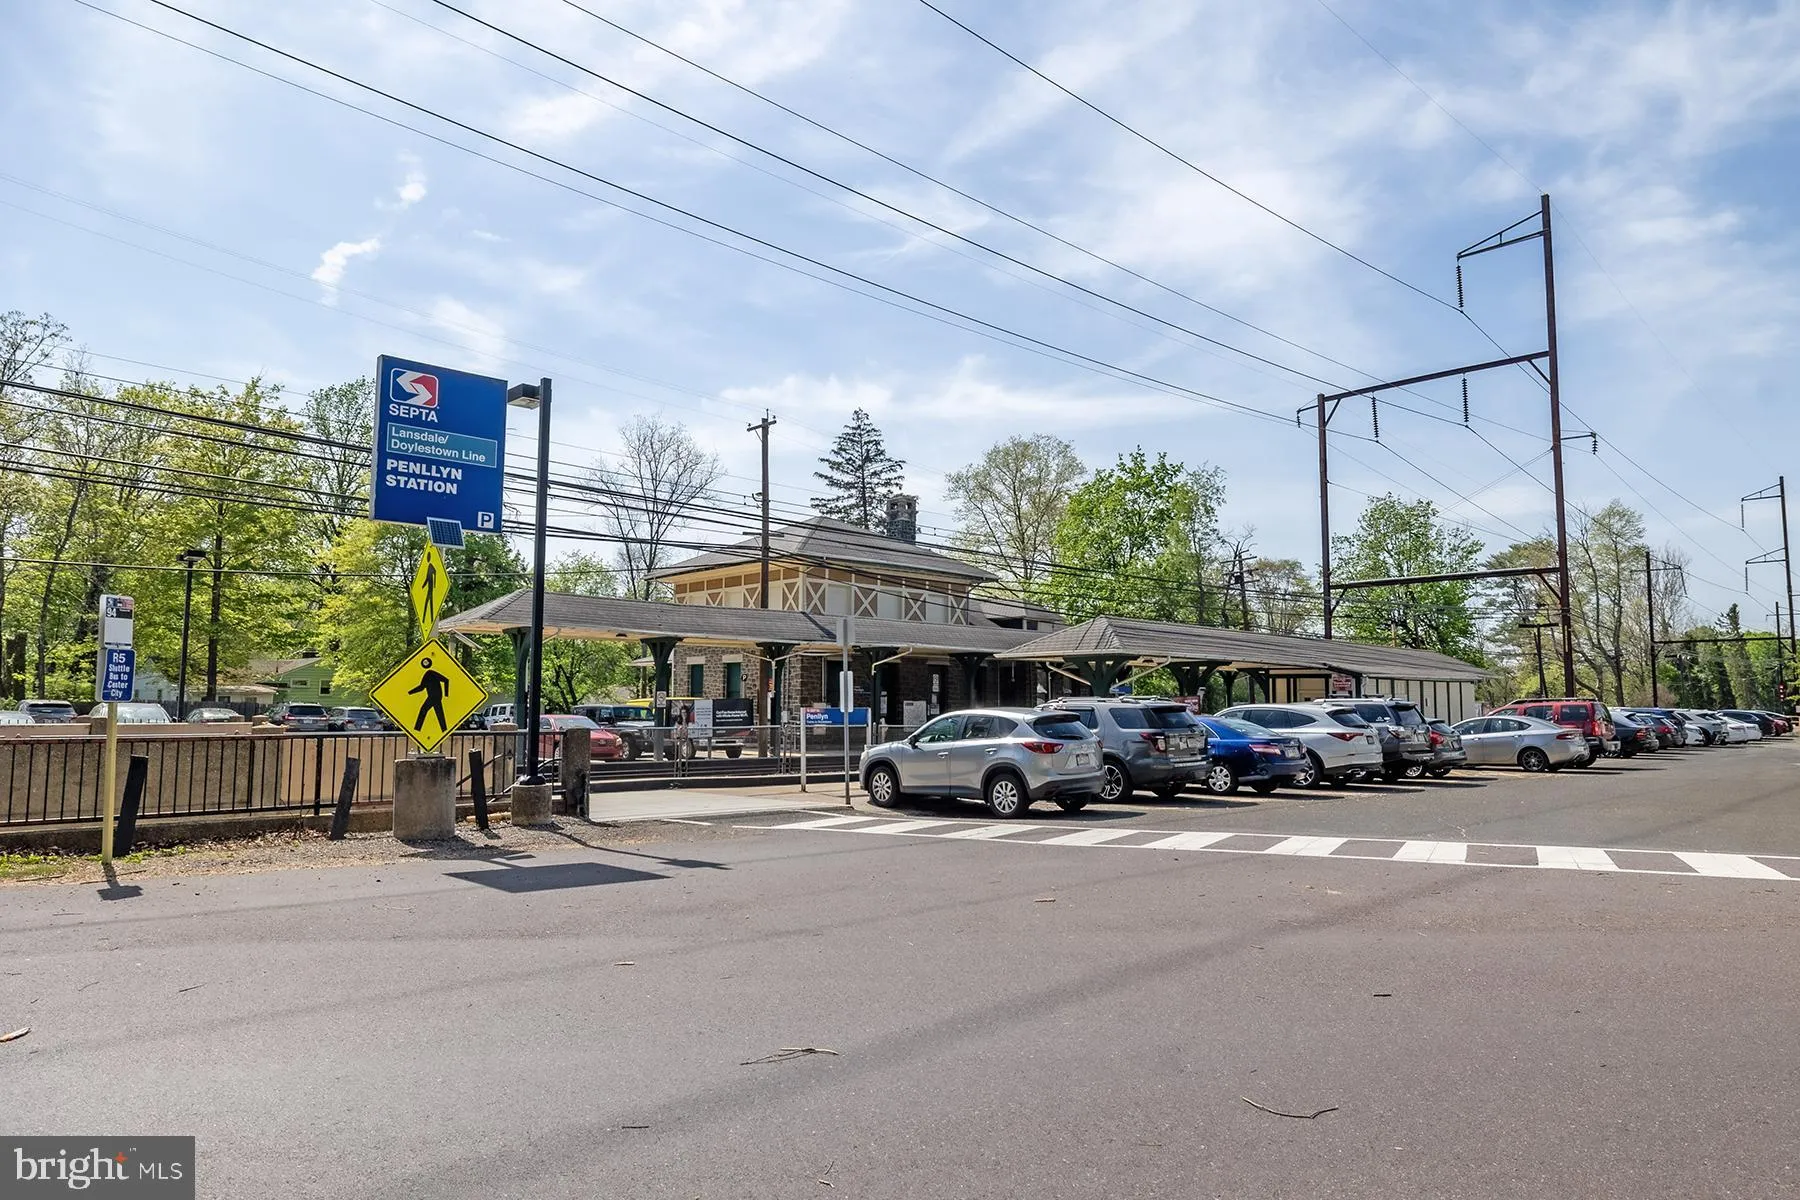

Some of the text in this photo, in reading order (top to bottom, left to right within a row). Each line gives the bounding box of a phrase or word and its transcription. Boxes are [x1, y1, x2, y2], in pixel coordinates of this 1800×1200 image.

[389, 404, 438, 423] SEPTA
[391, 426, 449, 444] Lansdale/
[391, 439, 486, 463] Doylestown Line
[386, 459, 462, 480] PENLLYN
[385, 475, 458, 495] STATION
[480, 513, 492, 527] P
[112, 652, 127, 663] R5
[108, 664, 131, 672] Shuttle
[109, 672, 128, 681] Bus to
[107, 681, 129, 689] Center
[110, 689, 123, 698] City
[806, 713, 829, 721] Penllyn
